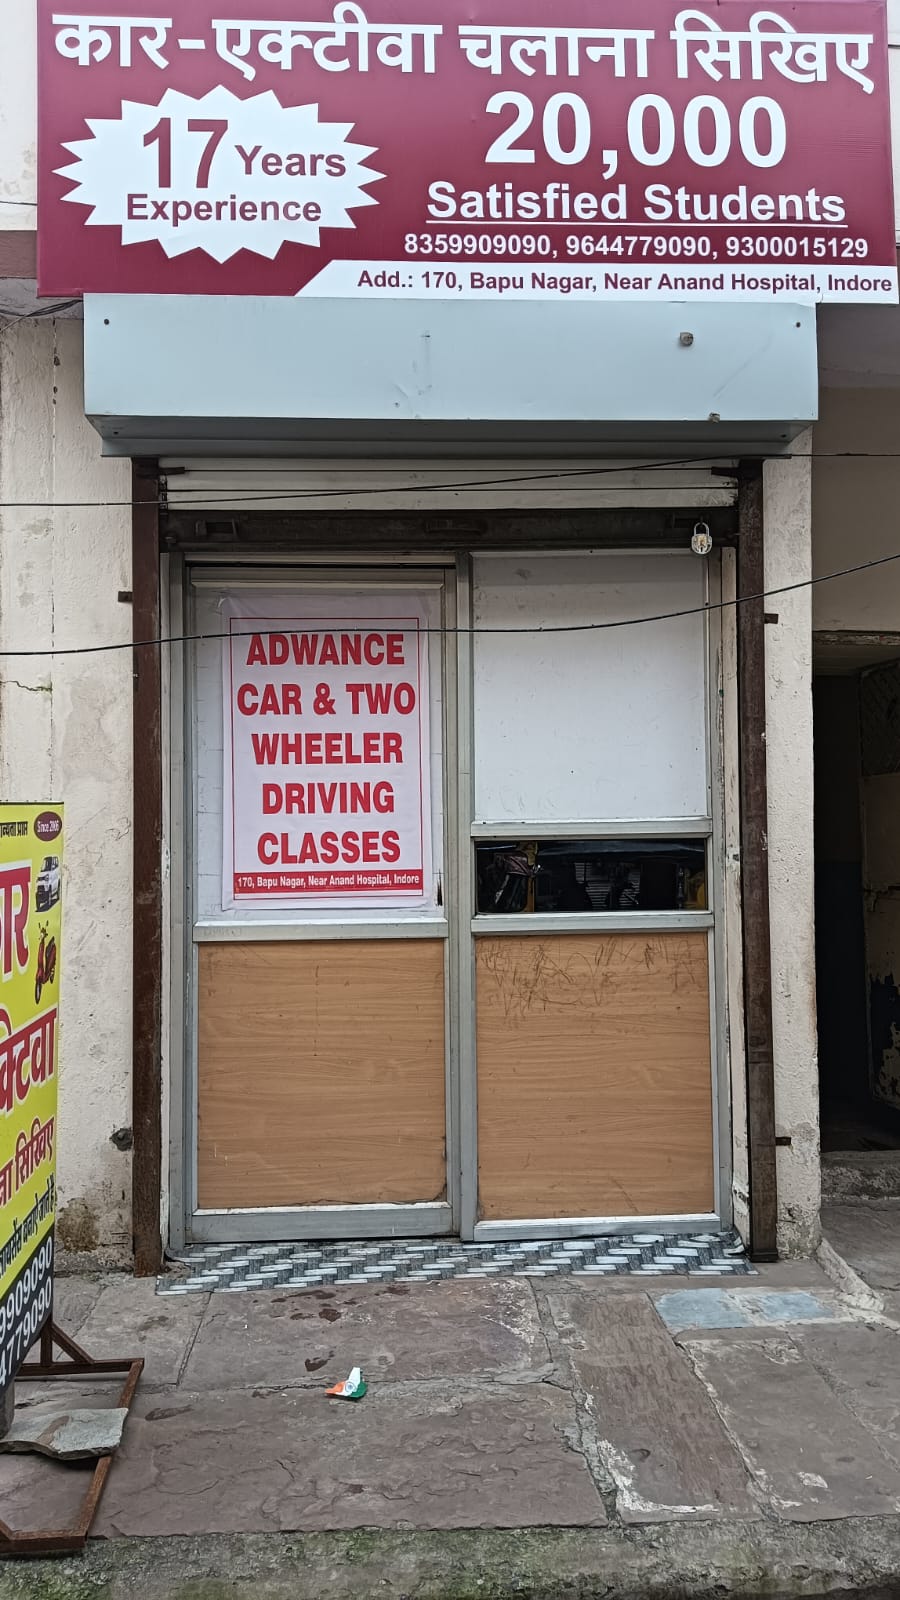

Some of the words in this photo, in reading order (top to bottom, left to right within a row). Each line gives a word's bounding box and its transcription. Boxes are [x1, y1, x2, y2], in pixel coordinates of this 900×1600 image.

[458, 23, 655, 78] चलाना
[669, 8, 875, 96] सिखिए
[485, 90, 787, 180] 20,000
[143, 117, 229, 189] 17
[234, 142, 350, 178] Years
[127, 193, 324, 229] Experience
[427, 180, 627, 220] Satisfied
[643, 183, 846, 222] Students
[404, 233, 558, 259] 8359909090,
[566, 235, 718, 260] 9644779090,
[726, 236, 868, 258] 9300015129
[357, 270, 413, 288] Add.:
[421, 271, 463, 292] 170,
[470, 271, 524, 294] Bapu
[531, 272, 597, 294] Nagar,
[604, 272, 653, 290] Near
[660, 273, 724, 290] Anand
[731, 273, 821, 295] Hospital,
[828, 274, 892, 292] Indore
[247, 633, 405, 666] ADWANCE
[237, 683, 303, 716] CAR
[313, 683, 336, 716] &
[345, 682, 416, 715] TWO
[251, 732, 403, 765] WHEELER
[262, 780, 395, 815] DRIVING
[257, 830, 401, 865] CLASSES
[237, 876, 255, 889] 170,
[256, 876, 278, 889] Bapu
[279, 875, 306, 889] Nagar,
[308, 875, 328, 887] Near
[329, 874, 354, 886] Anand
[356, 873, 392, 887] Hospital,
[393, 873, 420, 885] Indore
[15, 1117, 55, 1192] सिखिए
[0, 1236, 53, 1345] 9909090
[0, 1276, 52, 1386] 4779090
